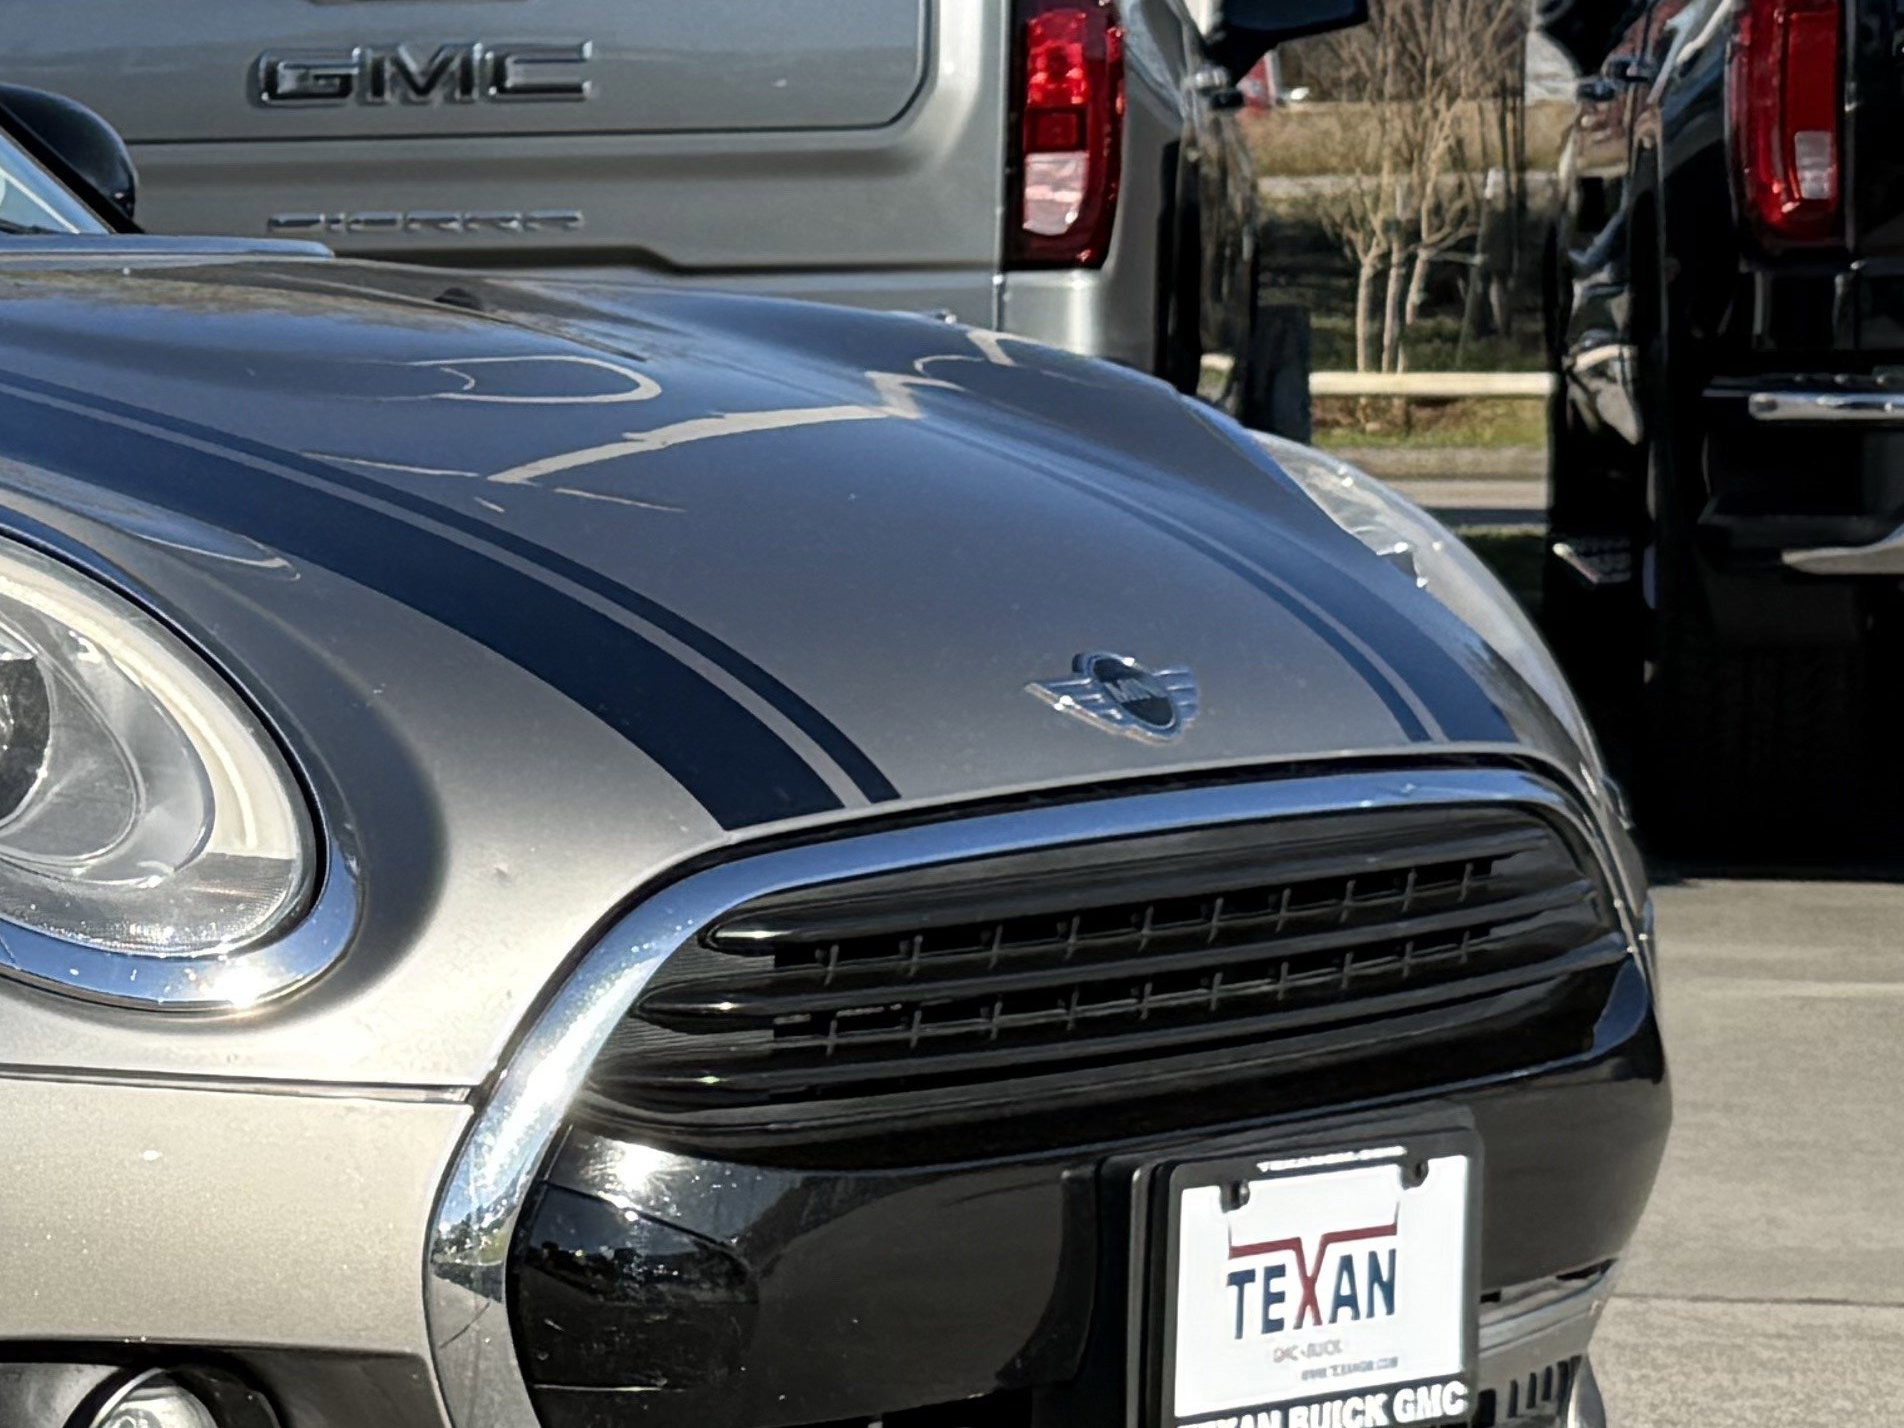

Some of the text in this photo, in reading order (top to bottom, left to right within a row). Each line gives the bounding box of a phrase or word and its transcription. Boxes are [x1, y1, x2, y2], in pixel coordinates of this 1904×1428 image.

[248, 40, 592, 107] GMC
[1226, 1224, 1397, 1341] TEXAN
[1392, 1380, 1469, 1424] GMC
